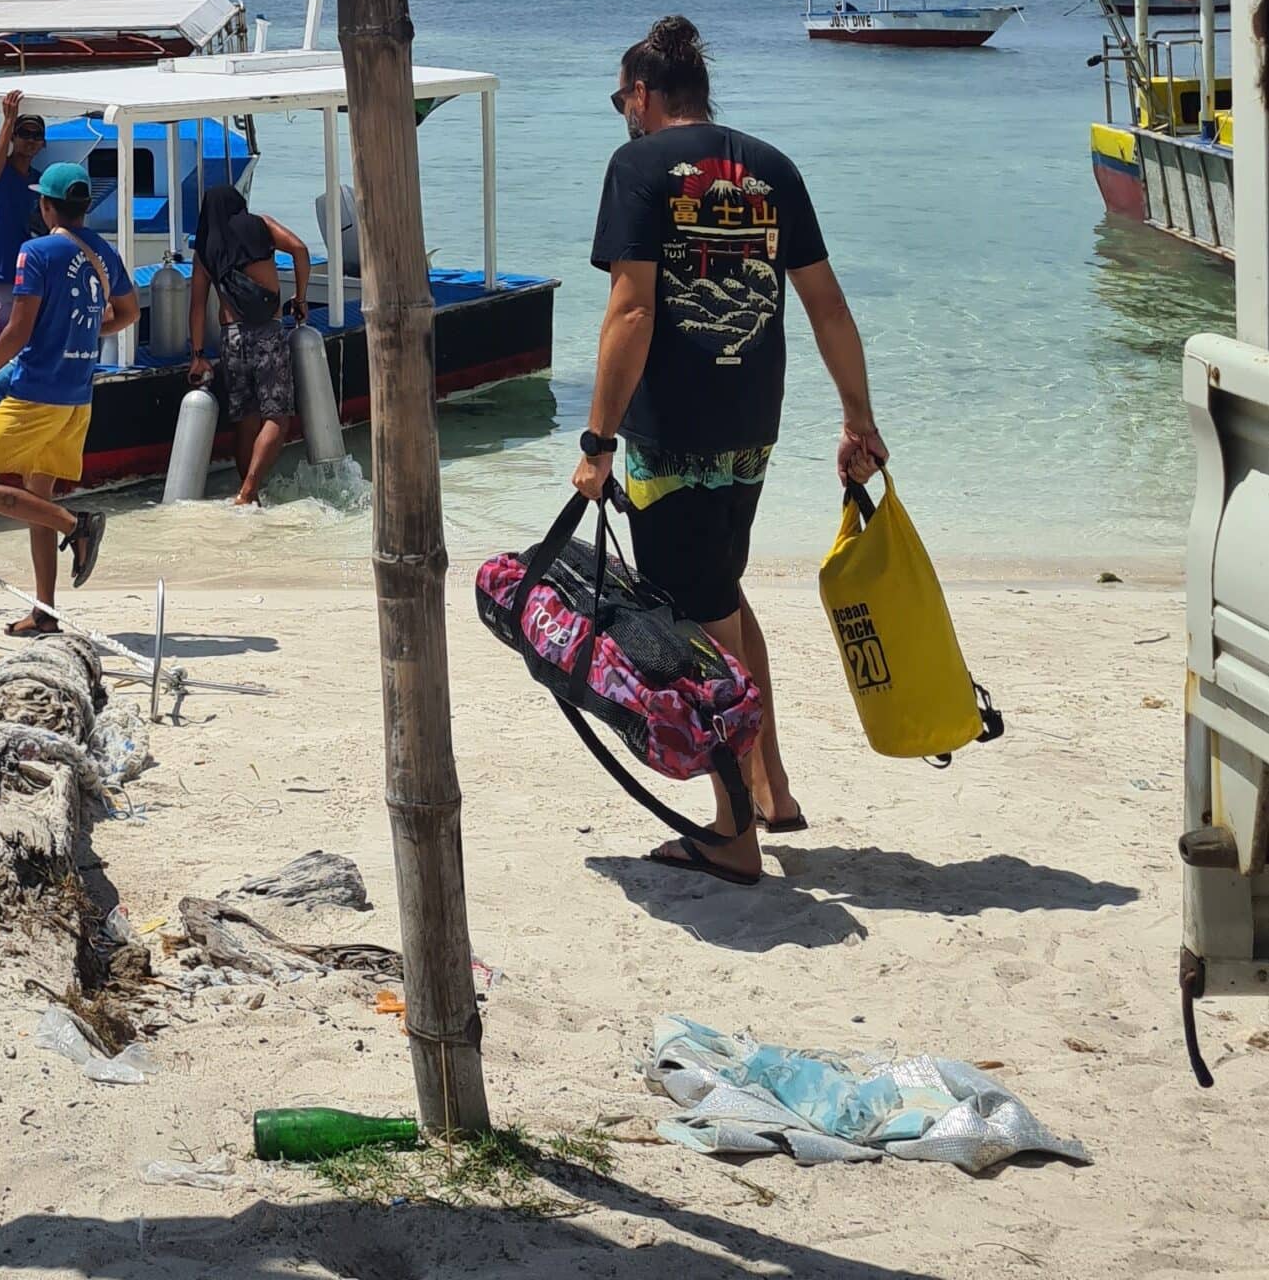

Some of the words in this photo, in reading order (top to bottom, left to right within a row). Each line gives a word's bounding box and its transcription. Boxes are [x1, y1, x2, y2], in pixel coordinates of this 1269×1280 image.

[830, 15, 849, 28] JUST
[852, 15, 872, 28] DIVE
[669, 195, 777, 225] 富士山
[846, 639, 889, 686] 20
